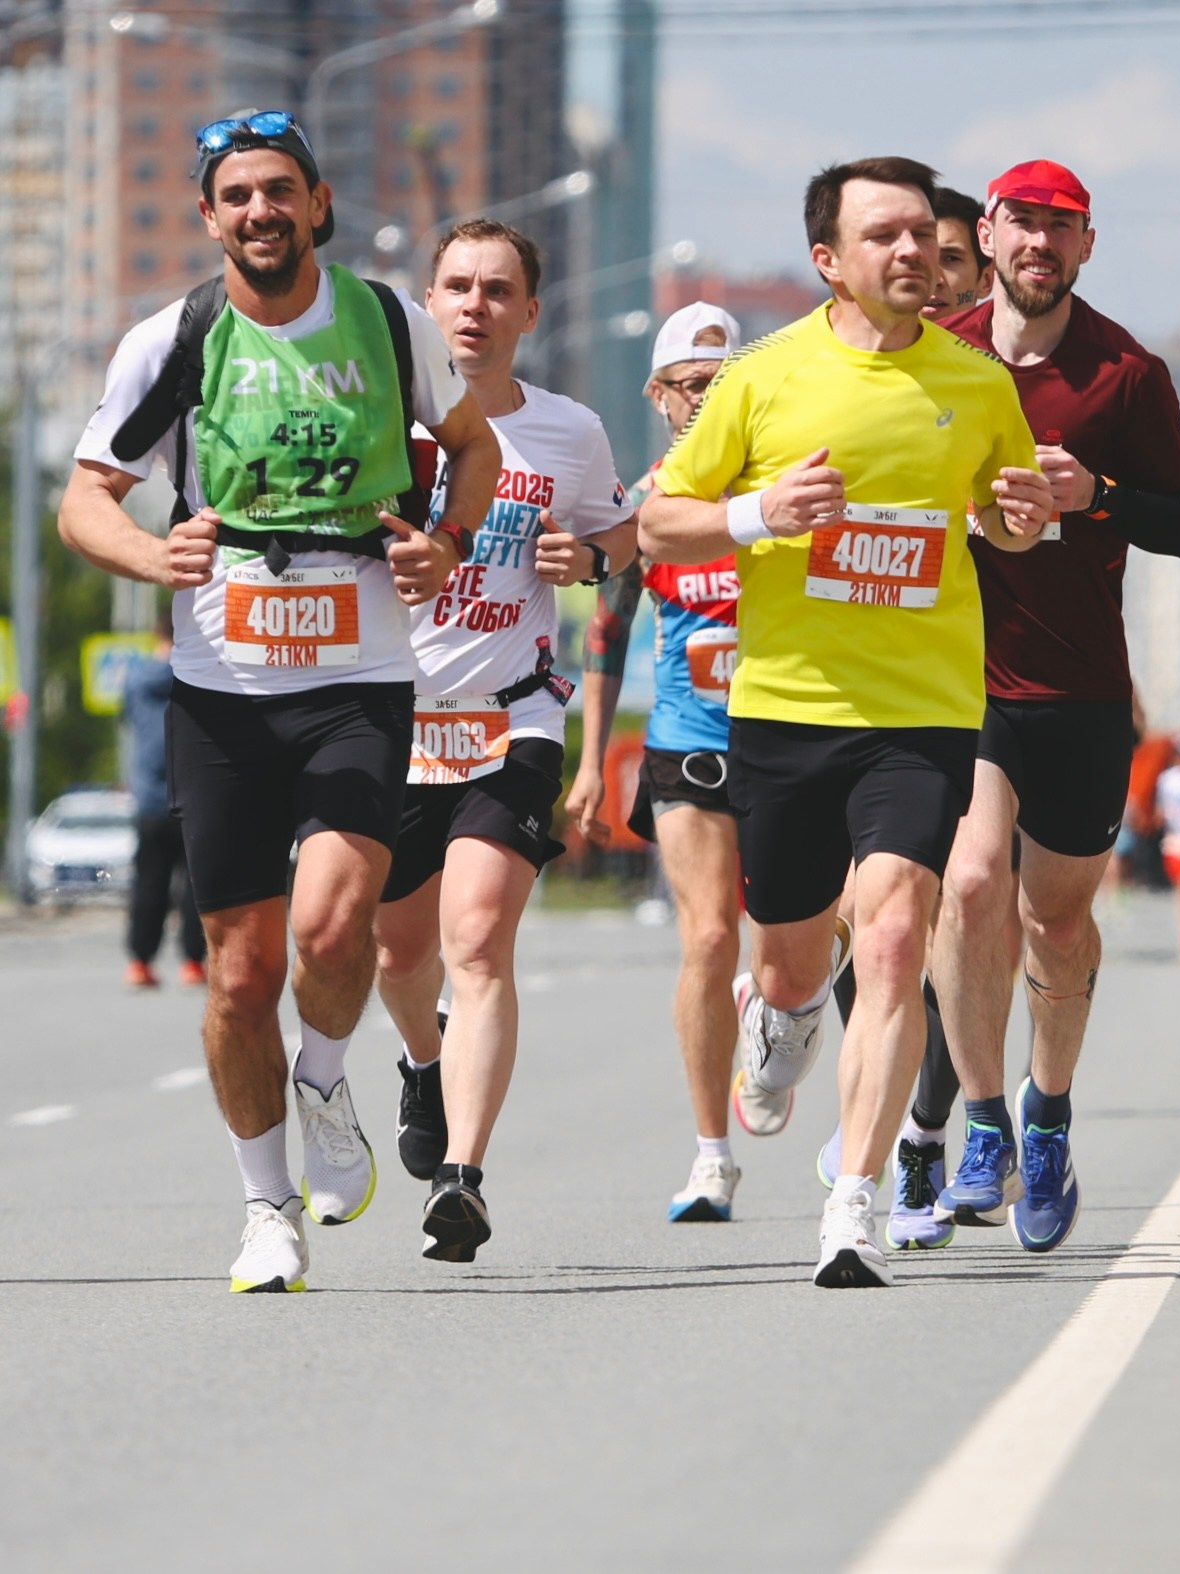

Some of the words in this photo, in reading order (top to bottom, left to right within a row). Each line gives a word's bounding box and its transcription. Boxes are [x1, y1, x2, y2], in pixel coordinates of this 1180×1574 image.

[231, 357, 279, 395] 21
[289, 409, 320, 419] ТЕМП:
[270, 422, 337, 447] 4:15
[246, 456, 268, 496] 1
[296, 456, 361, 497] 29
[496, 468, 555, 508] 2025
[831, 531, 926, 578] 40027
[247, 595, 336, 637] 40120
[433, 595, 452, 627] С
[455, 598, 526, 633] ТОБОЙ
